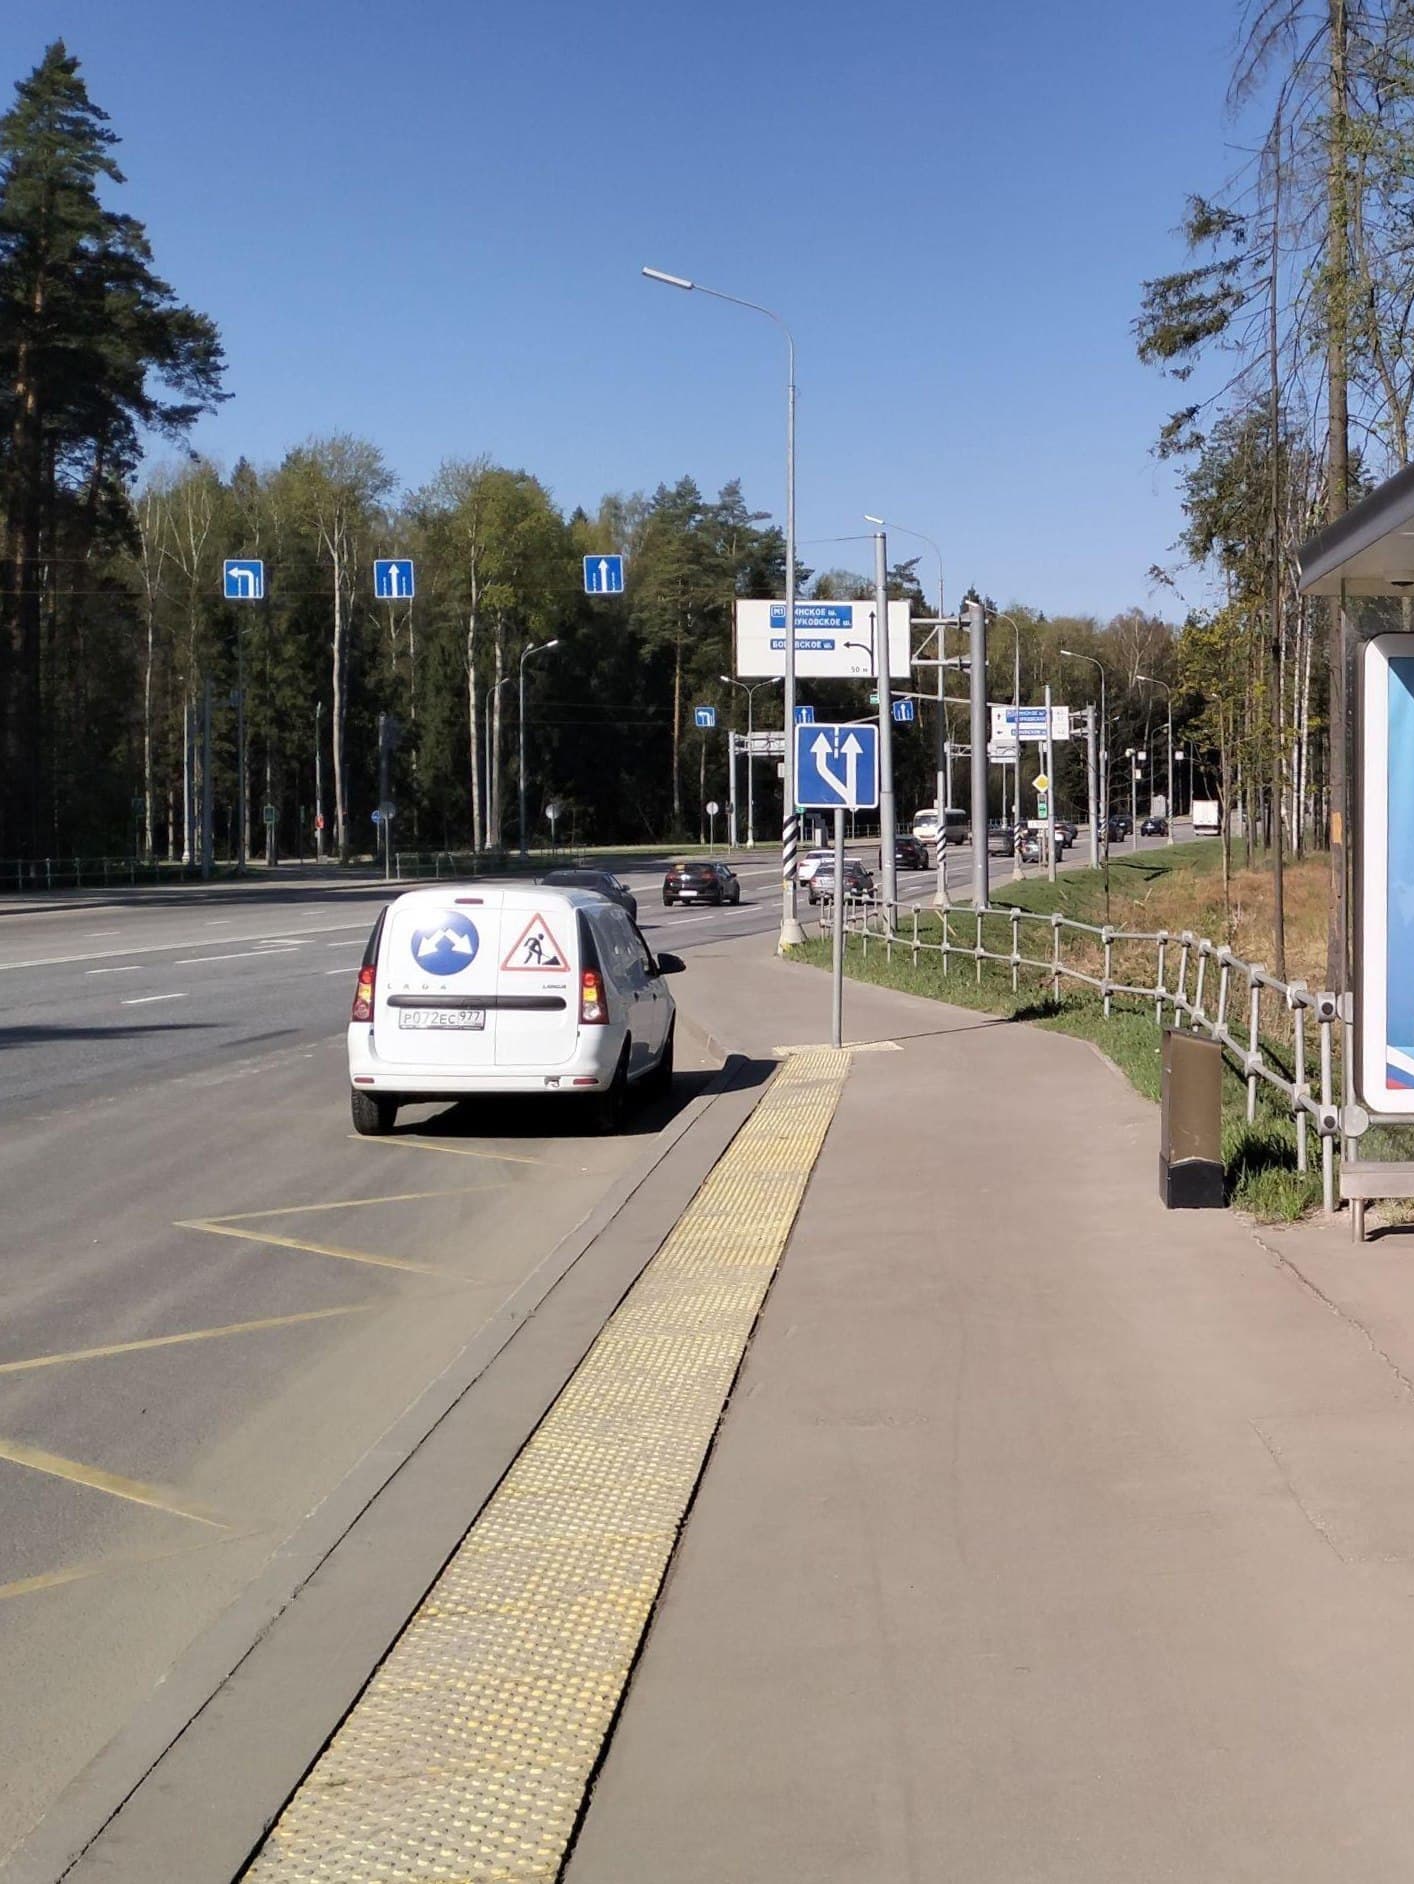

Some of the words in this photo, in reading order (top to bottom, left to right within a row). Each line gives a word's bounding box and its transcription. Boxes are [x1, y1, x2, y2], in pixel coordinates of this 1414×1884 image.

[795, 608, 826, 616] ИНСКОЕ
[795, 618, 841, 626] УКОВСКОЕ
[772, 641, 822, 649] БОВСКОЕ
[459, 1010, 482, 1022] 977
